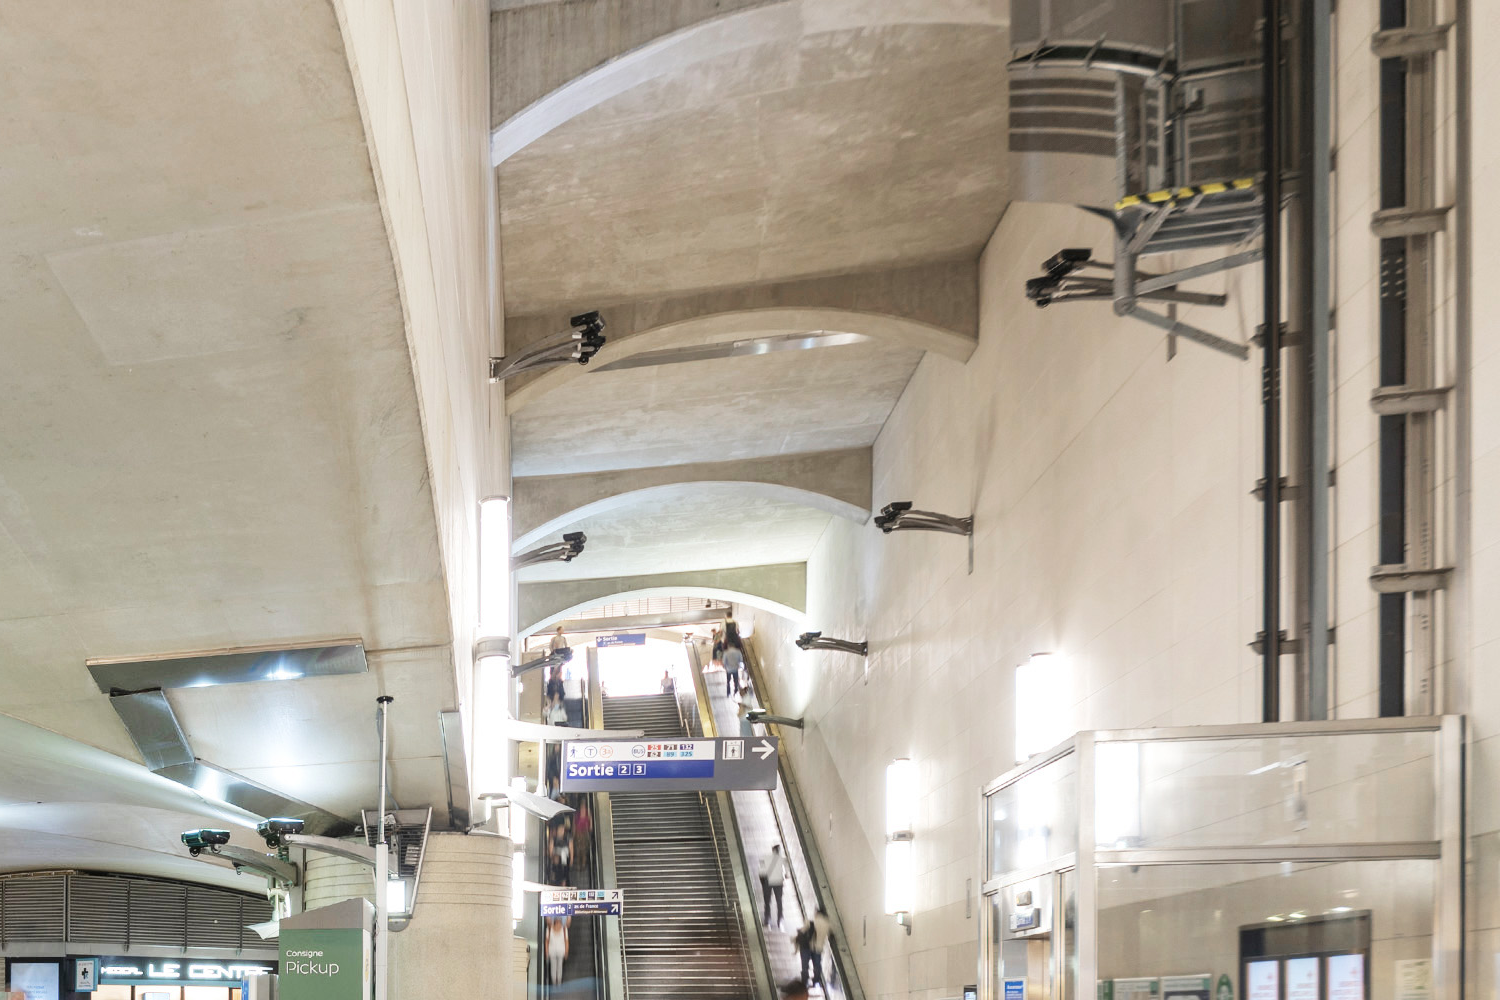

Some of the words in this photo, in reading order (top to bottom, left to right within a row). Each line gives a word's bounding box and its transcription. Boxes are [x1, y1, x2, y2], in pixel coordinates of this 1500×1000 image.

[569, 763, 614, 776] Sortie
[543, 905, 566, 914] Sortie
[286, 950, 323, 958] Consigne
[148, 963, 180, 978] LE
[286, 960, 339, 977] Pickup
